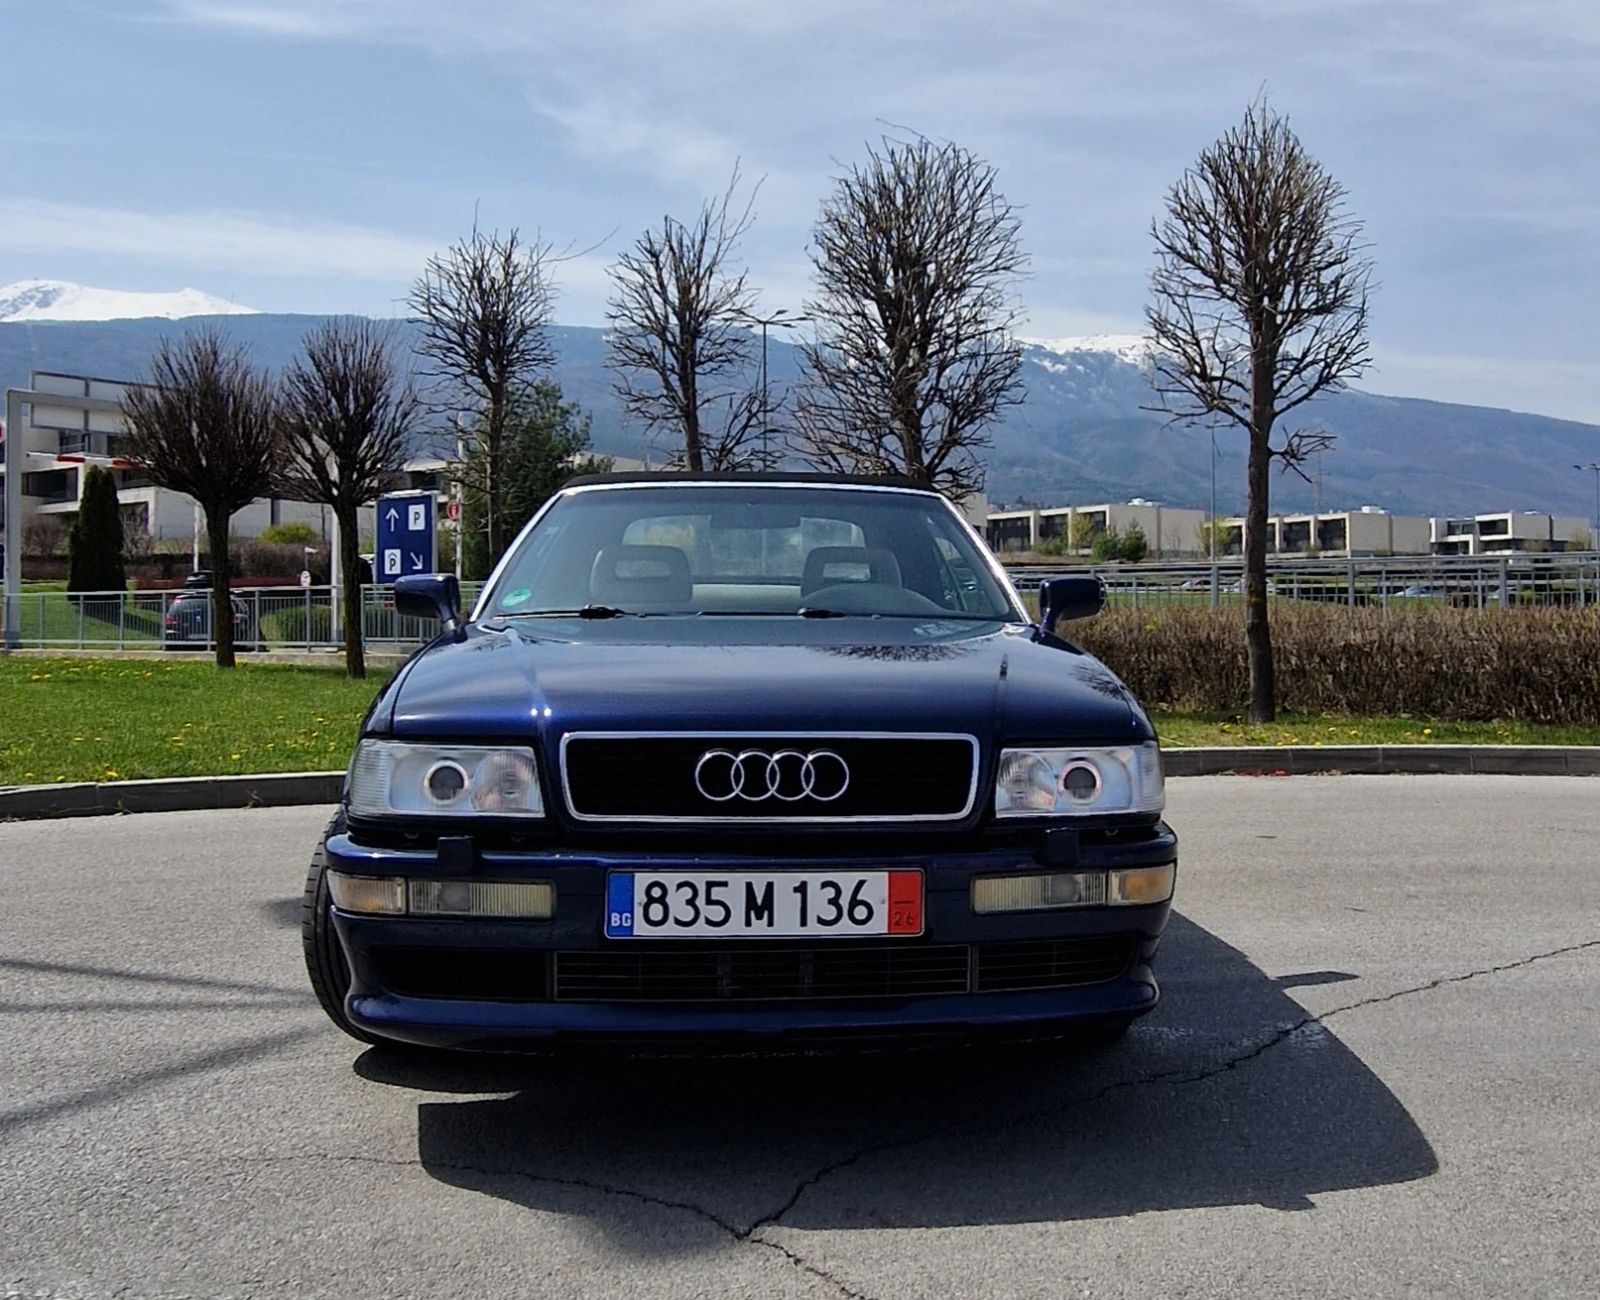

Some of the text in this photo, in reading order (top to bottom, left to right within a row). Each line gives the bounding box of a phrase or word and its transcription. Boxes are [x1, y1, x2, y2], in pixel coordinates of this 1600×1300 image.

[413, 511, 421, 525] P
[642, 879, 875, 928] 835 M 136
[610, 912, 632, 927] BG
[893, 911, 914, 926] 26
